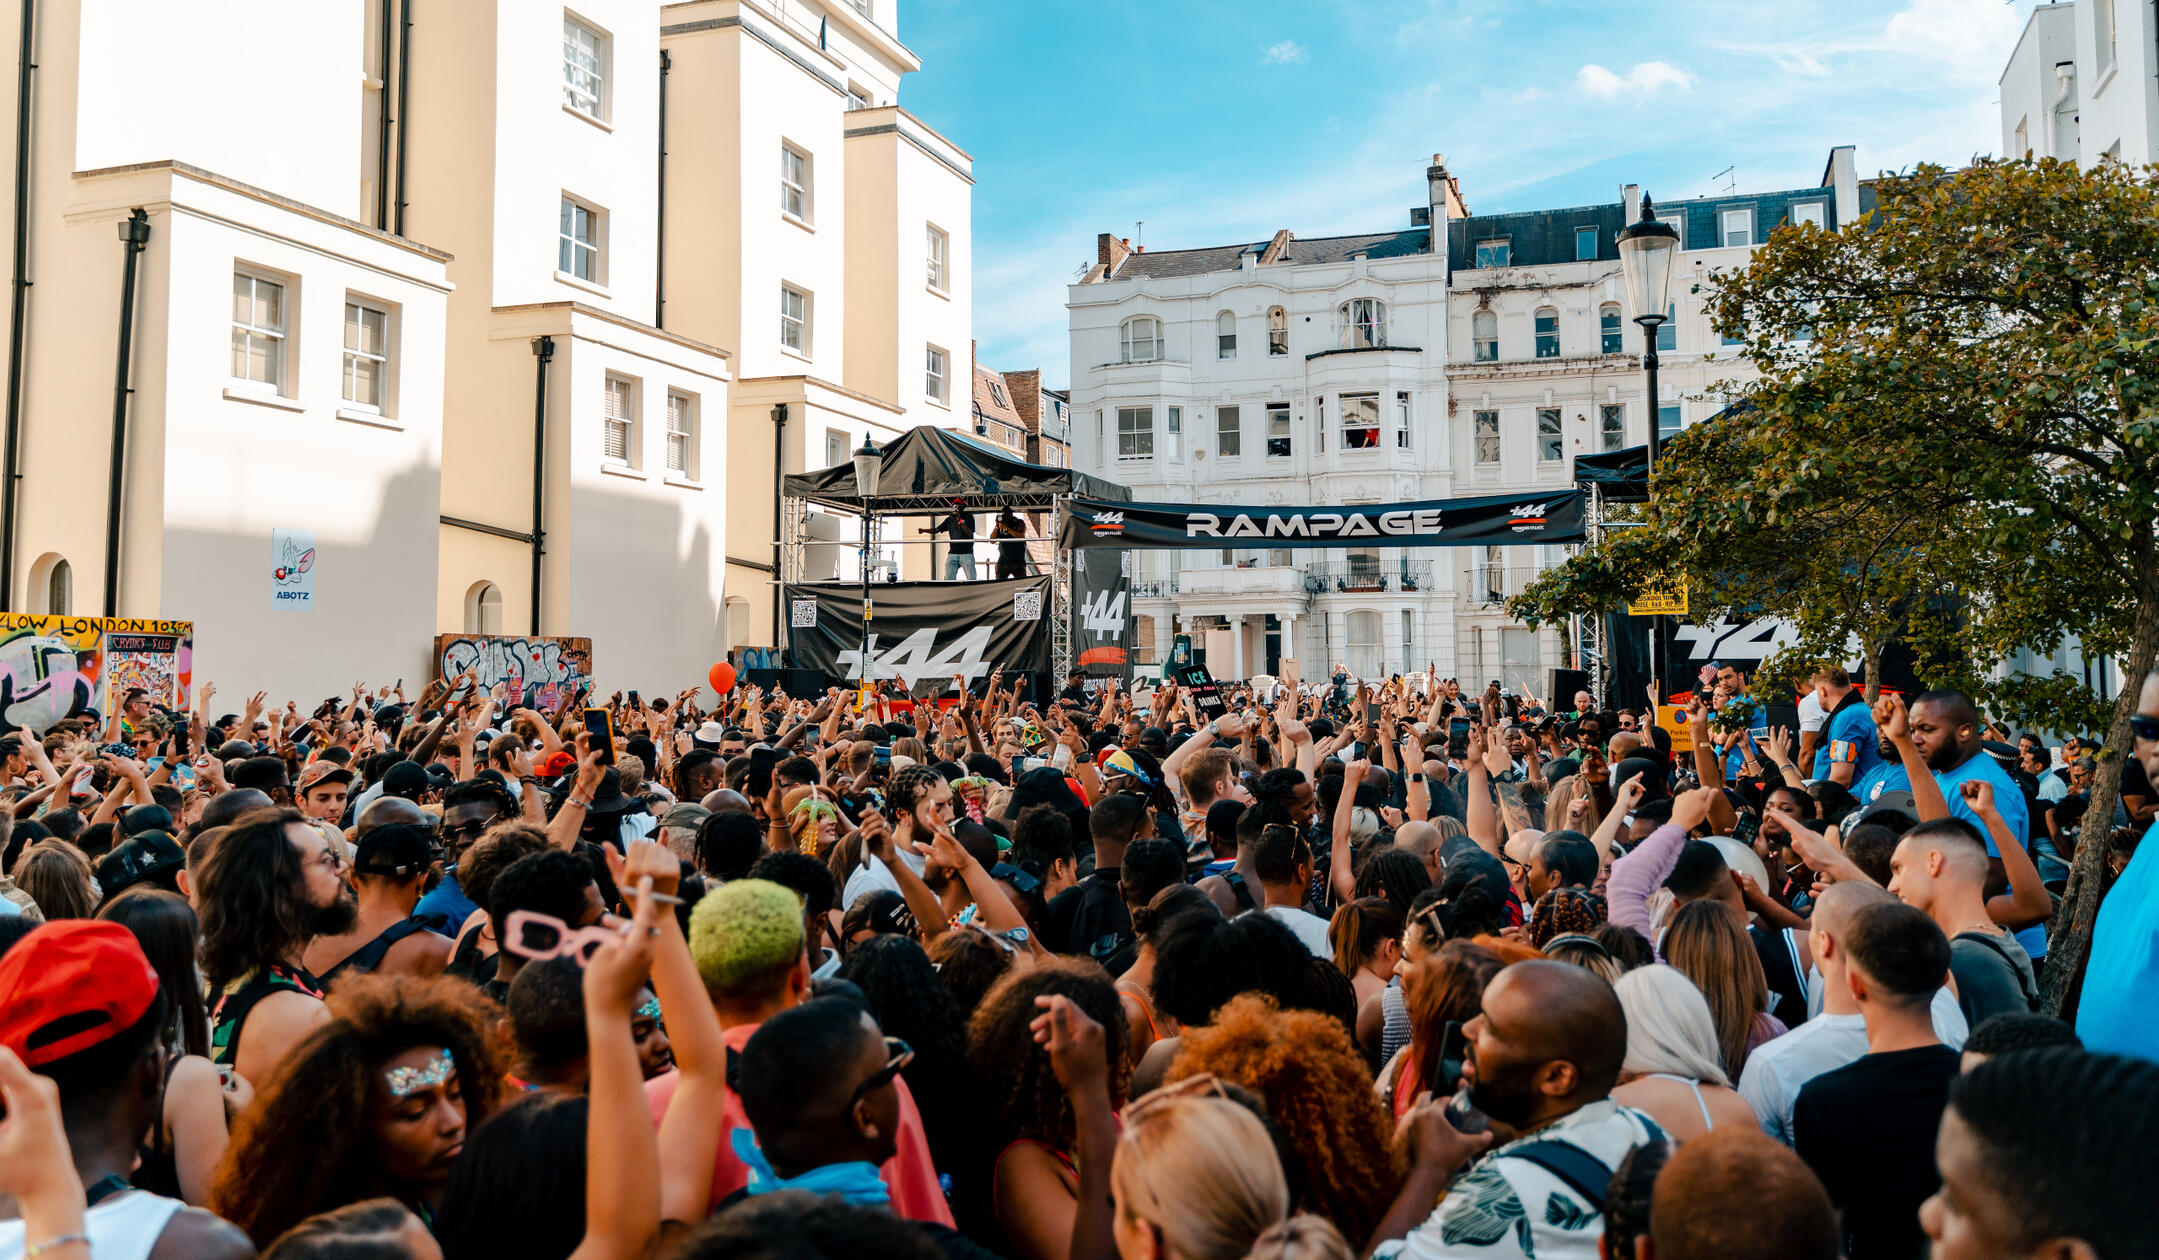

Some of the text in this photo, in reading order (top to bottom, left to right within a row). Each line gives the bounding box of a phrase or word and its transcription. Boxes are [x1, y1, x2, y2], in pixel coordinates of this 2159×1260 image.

[1092, 512, 1124, 524] +44
[1508, 504, 1546, 518] +44
[1186, 509, 1442, 537] RAMPAGE
[276, 591, 310, 600] ABOTZ
[1080, 590, 1126, 640] +44
[0, 614, 48, 631] LOW
[60, 617, 145, 637] LONDON
[836, 626, 995, 692] +44
[1186, 670, 1207, 685] ICE
[1198, 695, 1221, 707] DRINKS
